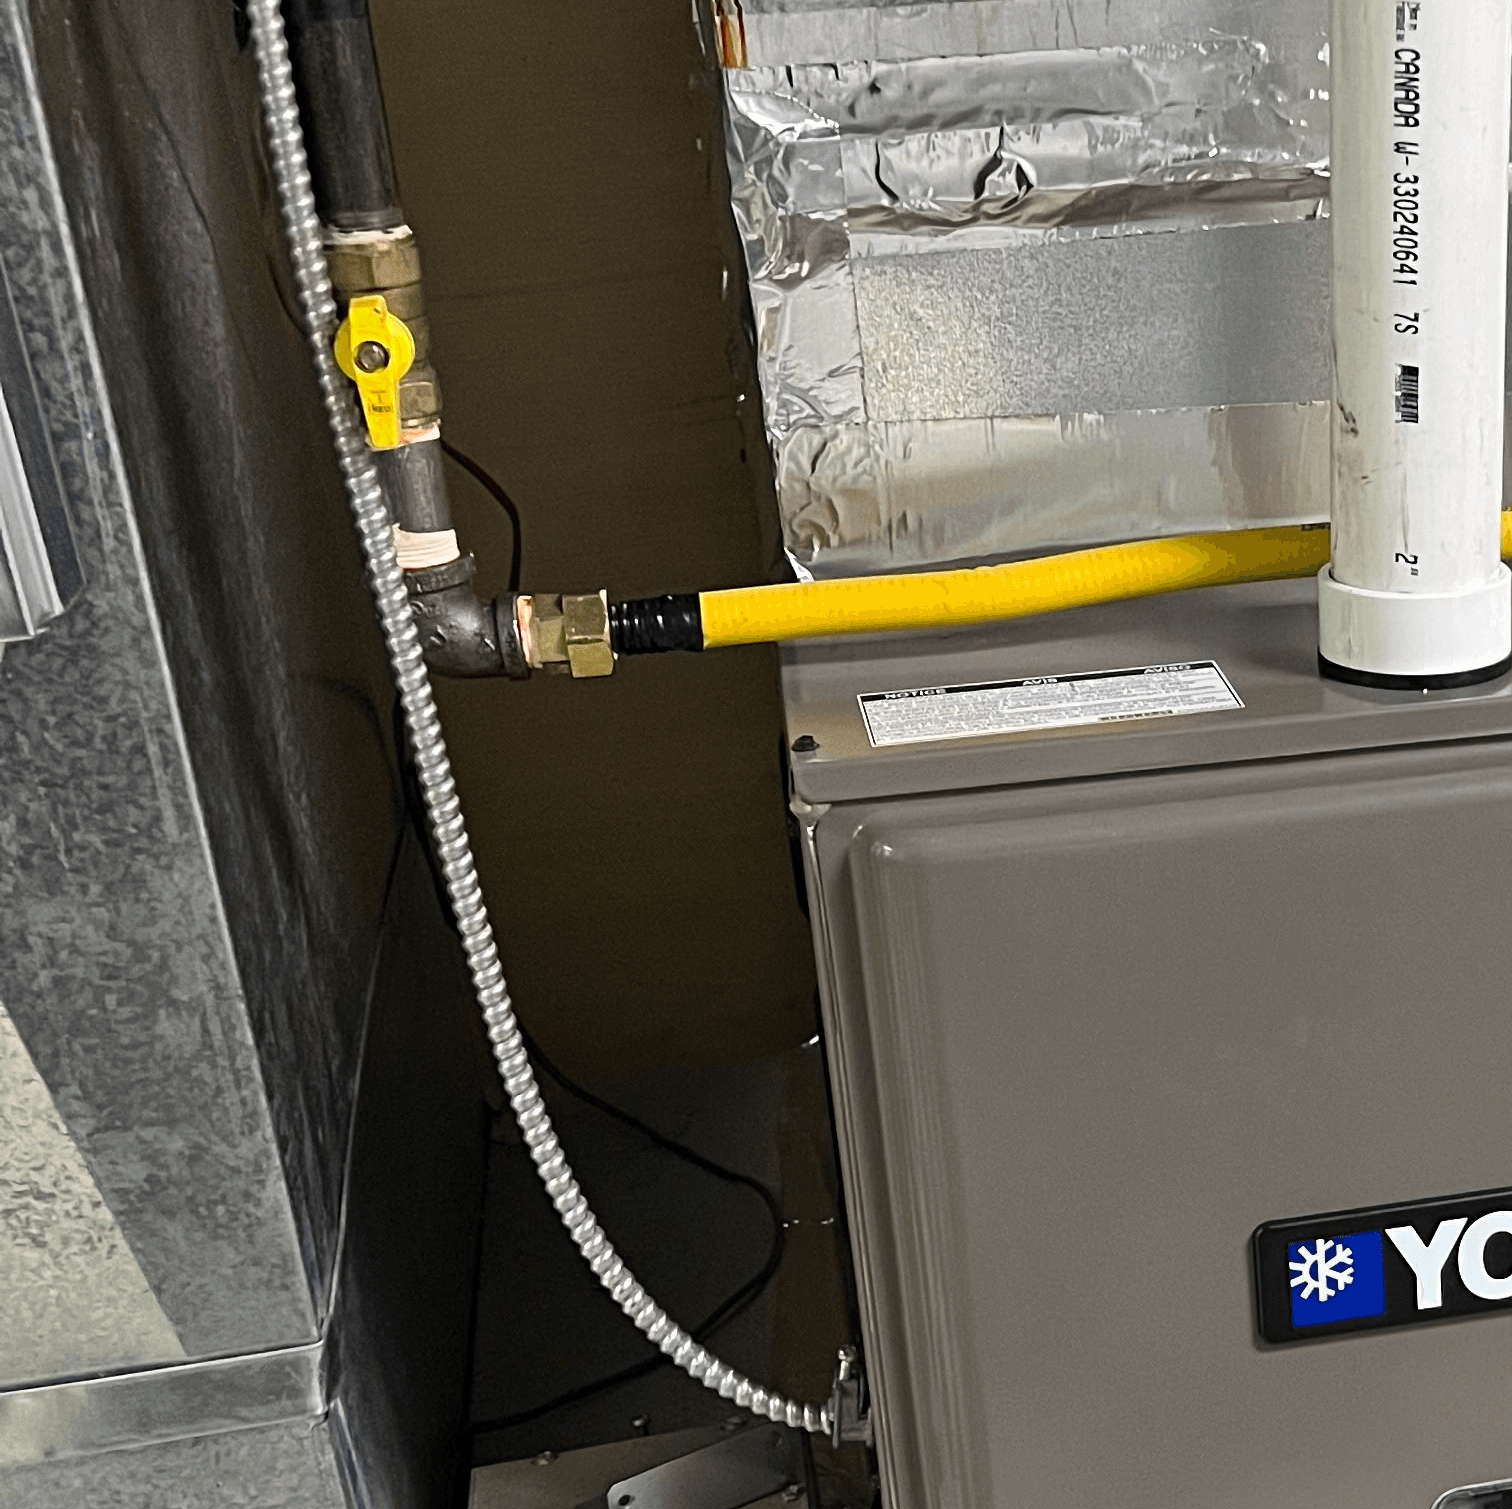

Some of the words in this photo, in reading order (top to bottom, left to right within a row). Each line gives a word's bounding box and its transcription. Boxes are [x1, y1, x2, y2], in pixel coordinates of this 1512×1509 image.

[1393, 48, 1420, 128] CANADA
[1393, 312, 1420, 335] 7S
[1022, 676, 1058, 687] AVIS
